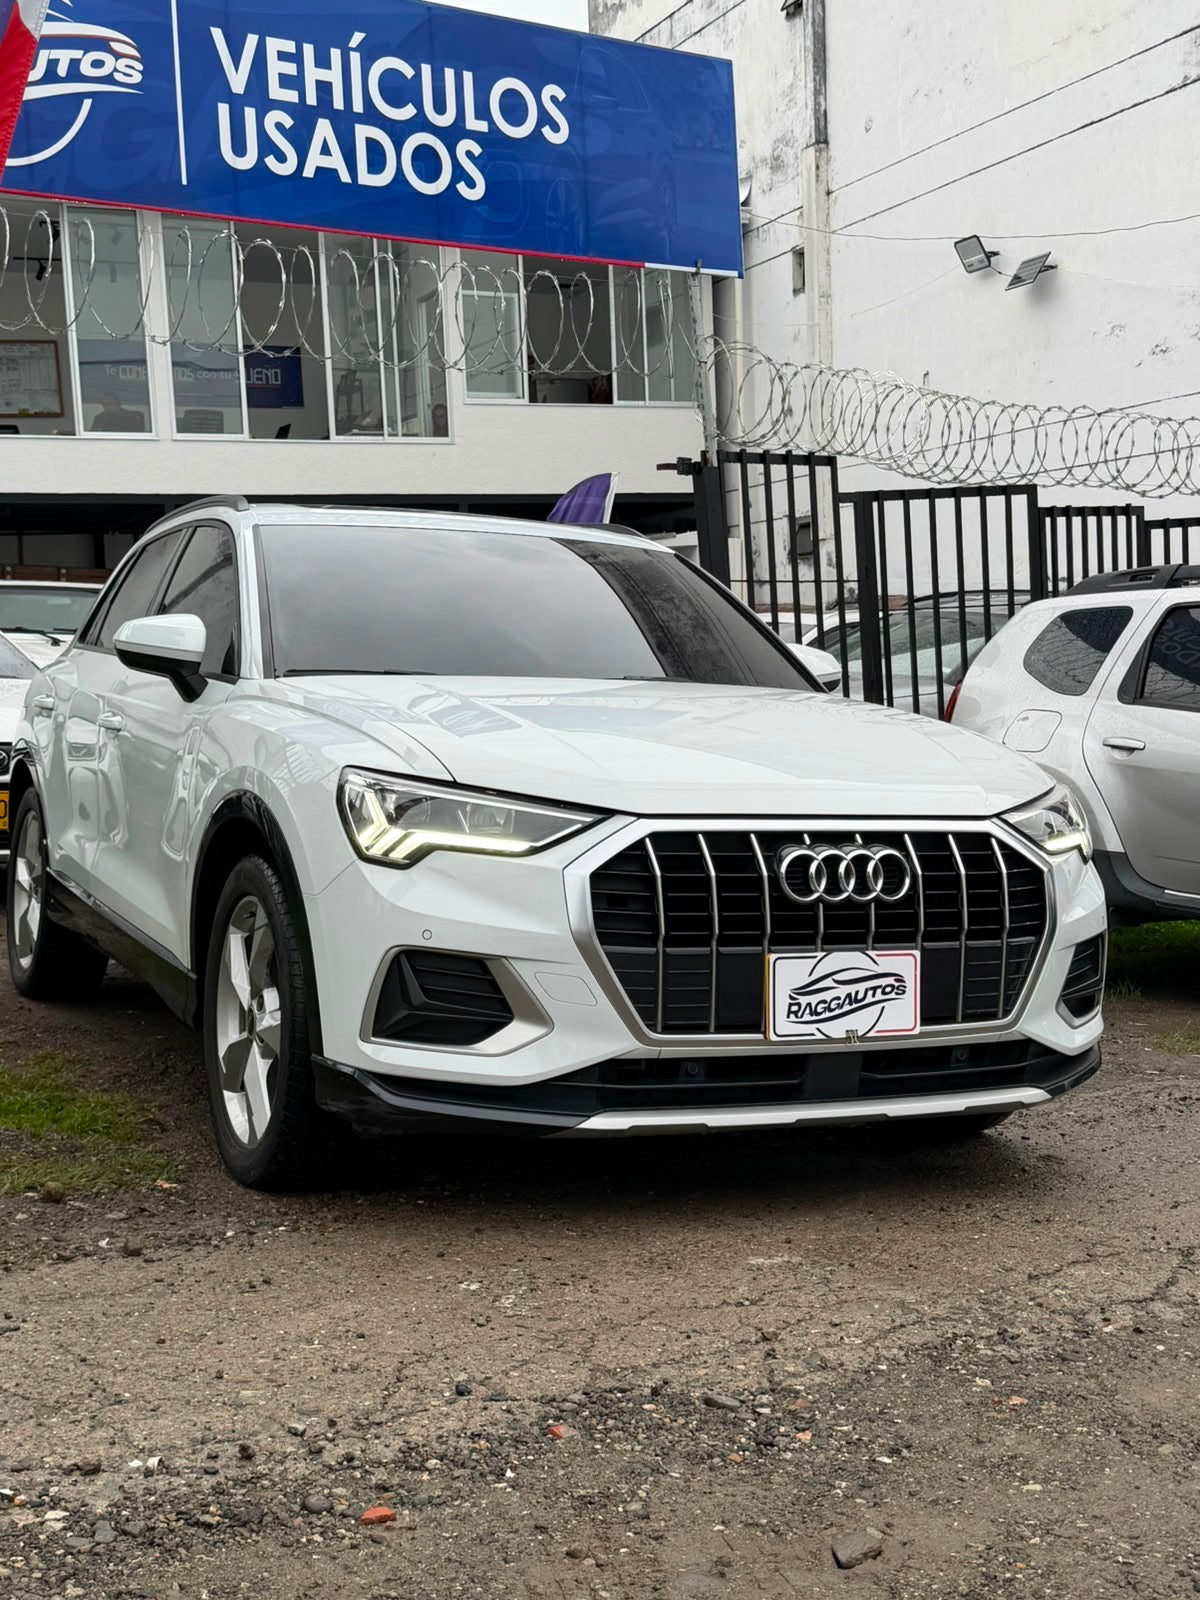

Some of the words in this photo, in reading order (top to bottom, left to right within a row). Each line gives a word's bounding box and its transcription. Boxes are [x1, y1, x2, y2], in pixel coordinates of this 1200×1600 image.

[209, 26, 570, 145] VEHÍCULOS
[216, 102, 487, 201] USADOS
[786, 983, 907, 1019] RAGGAUTOS
